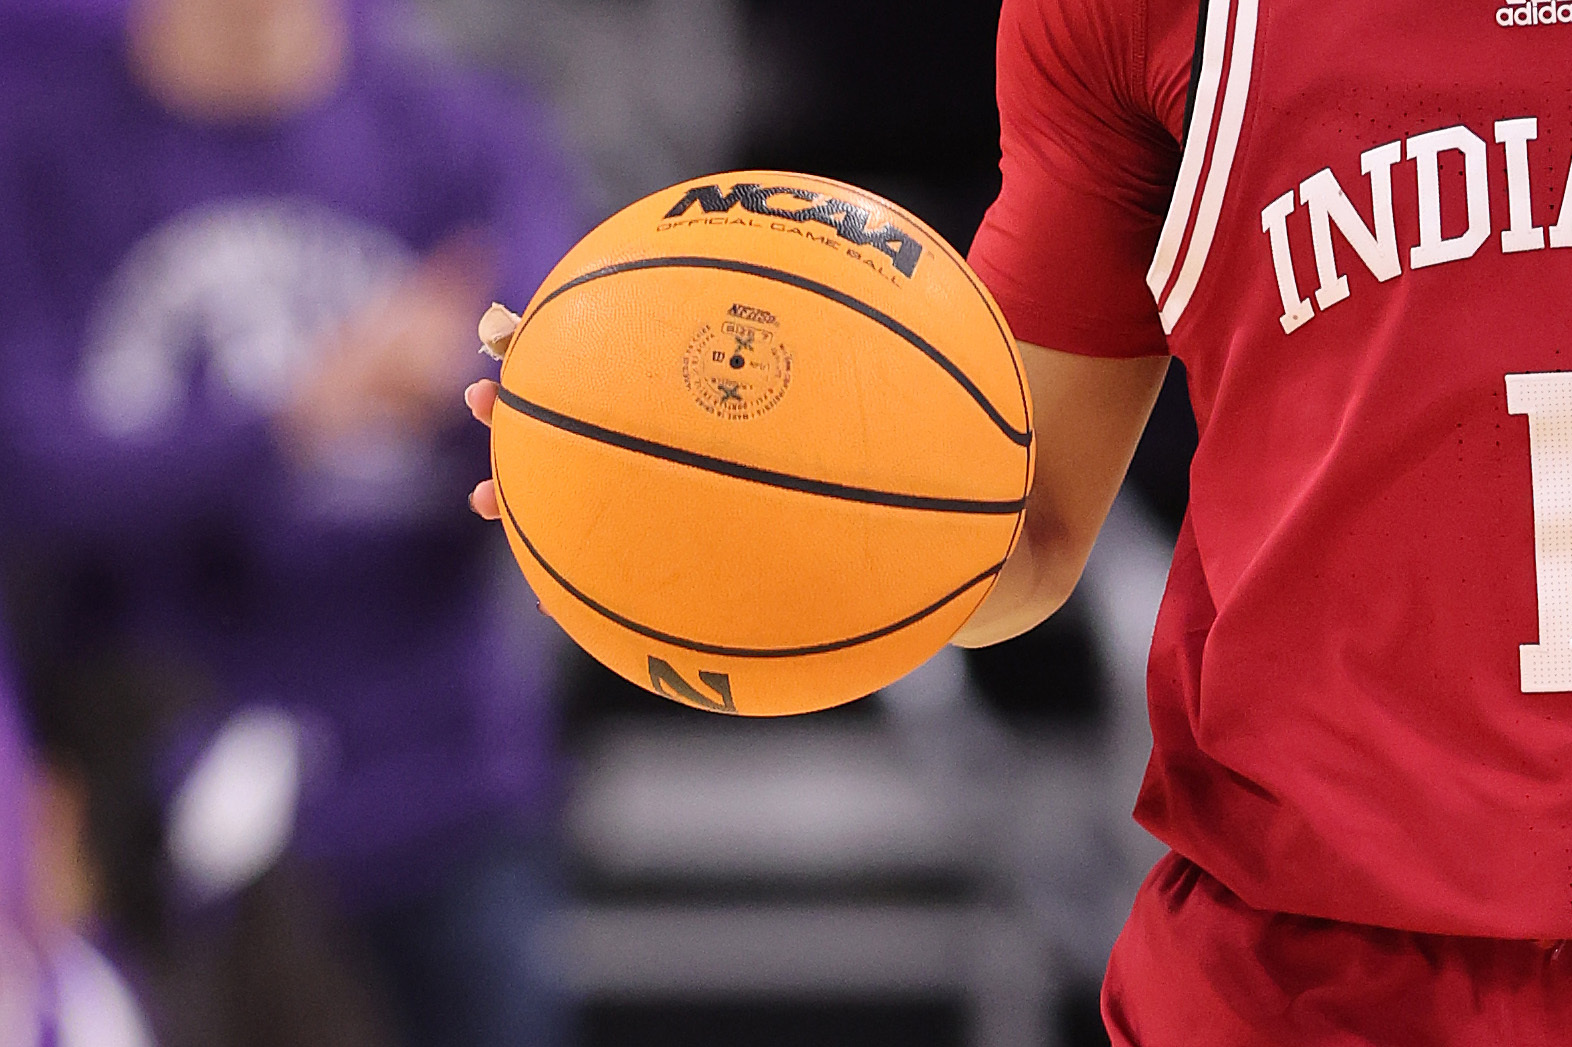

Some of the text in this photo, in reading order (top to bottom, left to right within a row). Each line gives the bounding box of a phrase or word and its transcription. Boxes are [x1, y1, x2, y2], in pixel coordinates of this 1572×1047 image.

[656, 216, 903, 288] OFFICIAL GAME BALL
[663, 183, 923, 279] NCAA
